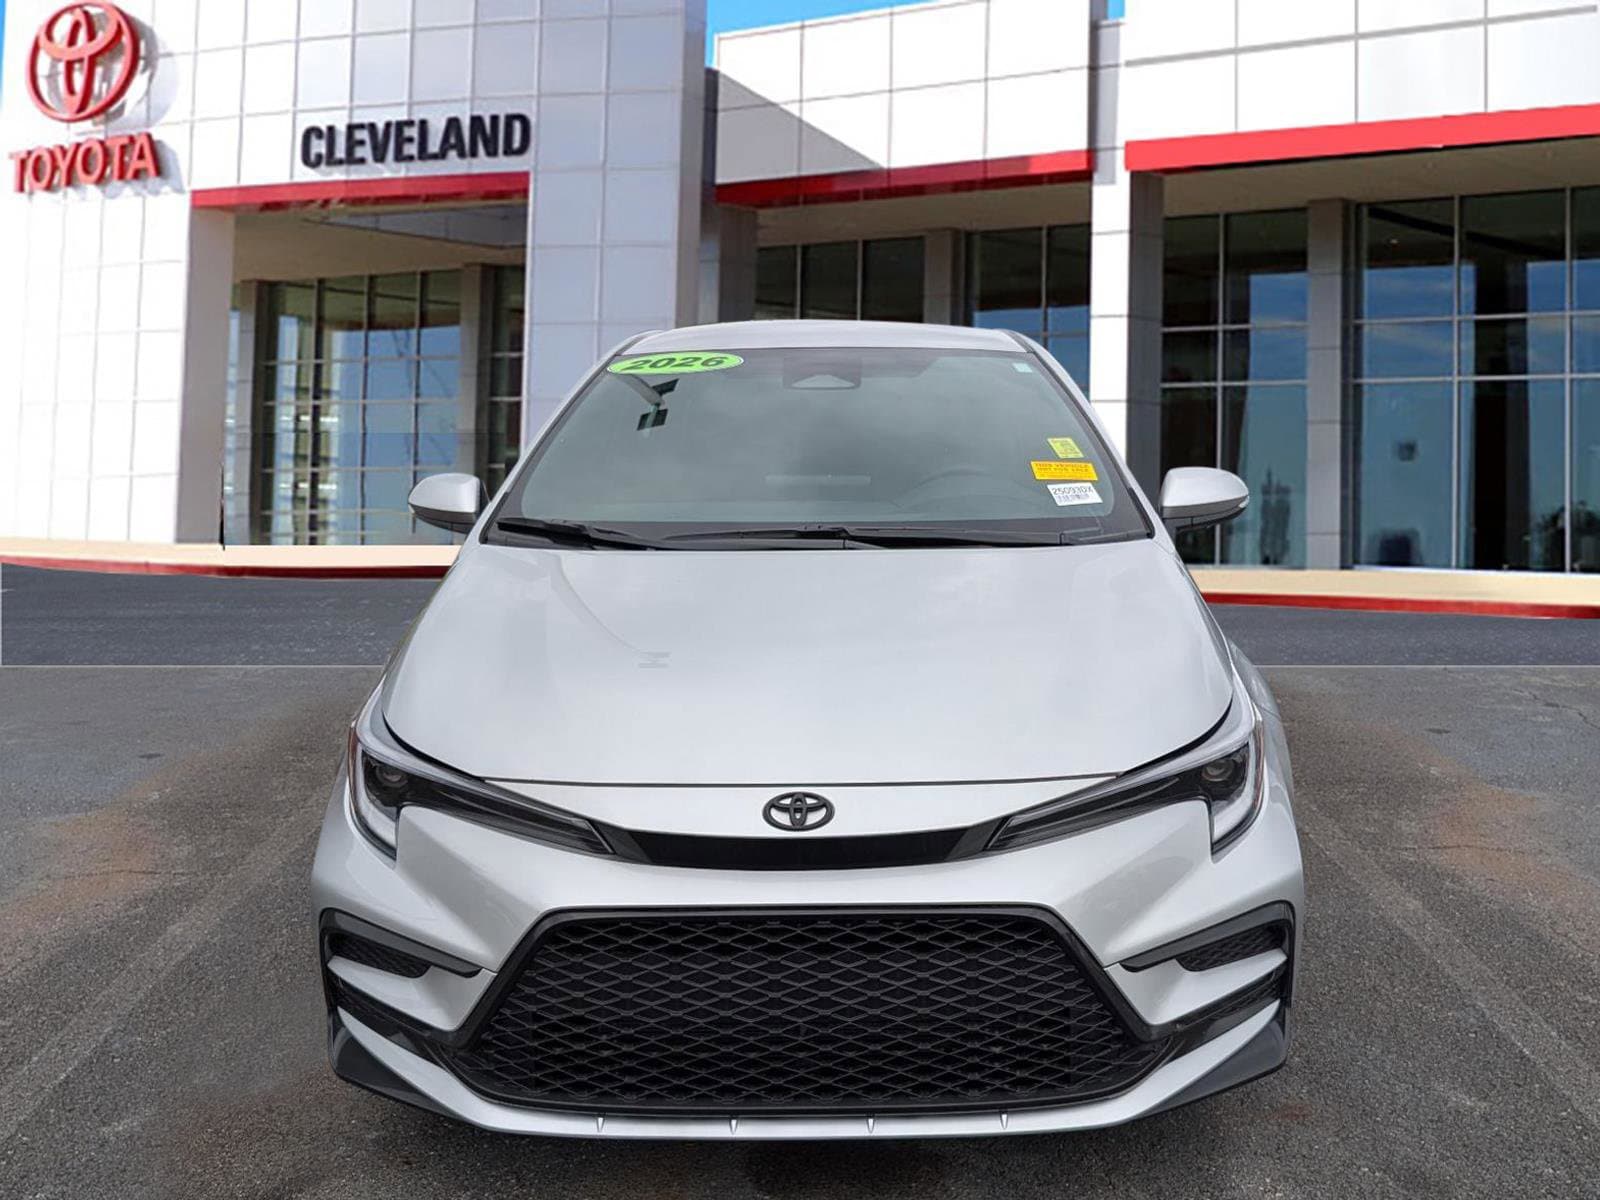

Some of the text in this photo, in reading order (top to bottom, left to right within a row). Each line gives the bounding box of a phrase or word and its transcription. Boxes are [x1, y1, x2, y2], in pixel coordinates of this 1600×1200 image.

[9, 132, 160, 193] TOYOTA
[301, 113, 531, 168] CLEVELAND
[621, 356, 729, 371] 2026
